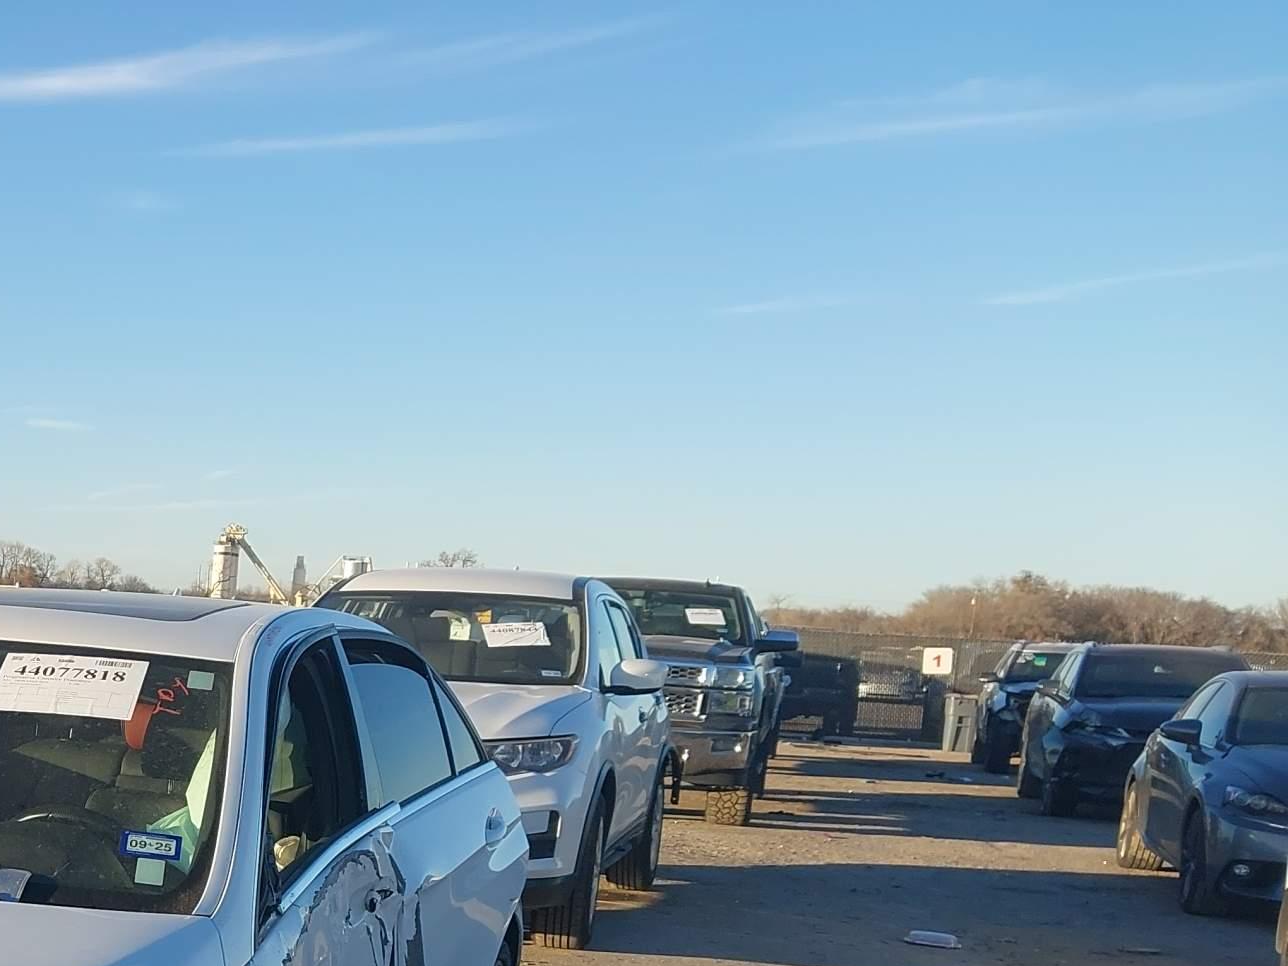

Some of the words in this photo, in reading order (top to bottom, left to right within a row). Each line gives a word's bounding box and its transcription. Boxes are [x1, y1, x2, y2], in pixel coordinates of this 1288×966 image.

[932, 654, 941, 668] 1
[13, 665, 127, 683] 44077818
[129, 839, 147, 849] 09
[155, 842, 172, 852] 25
